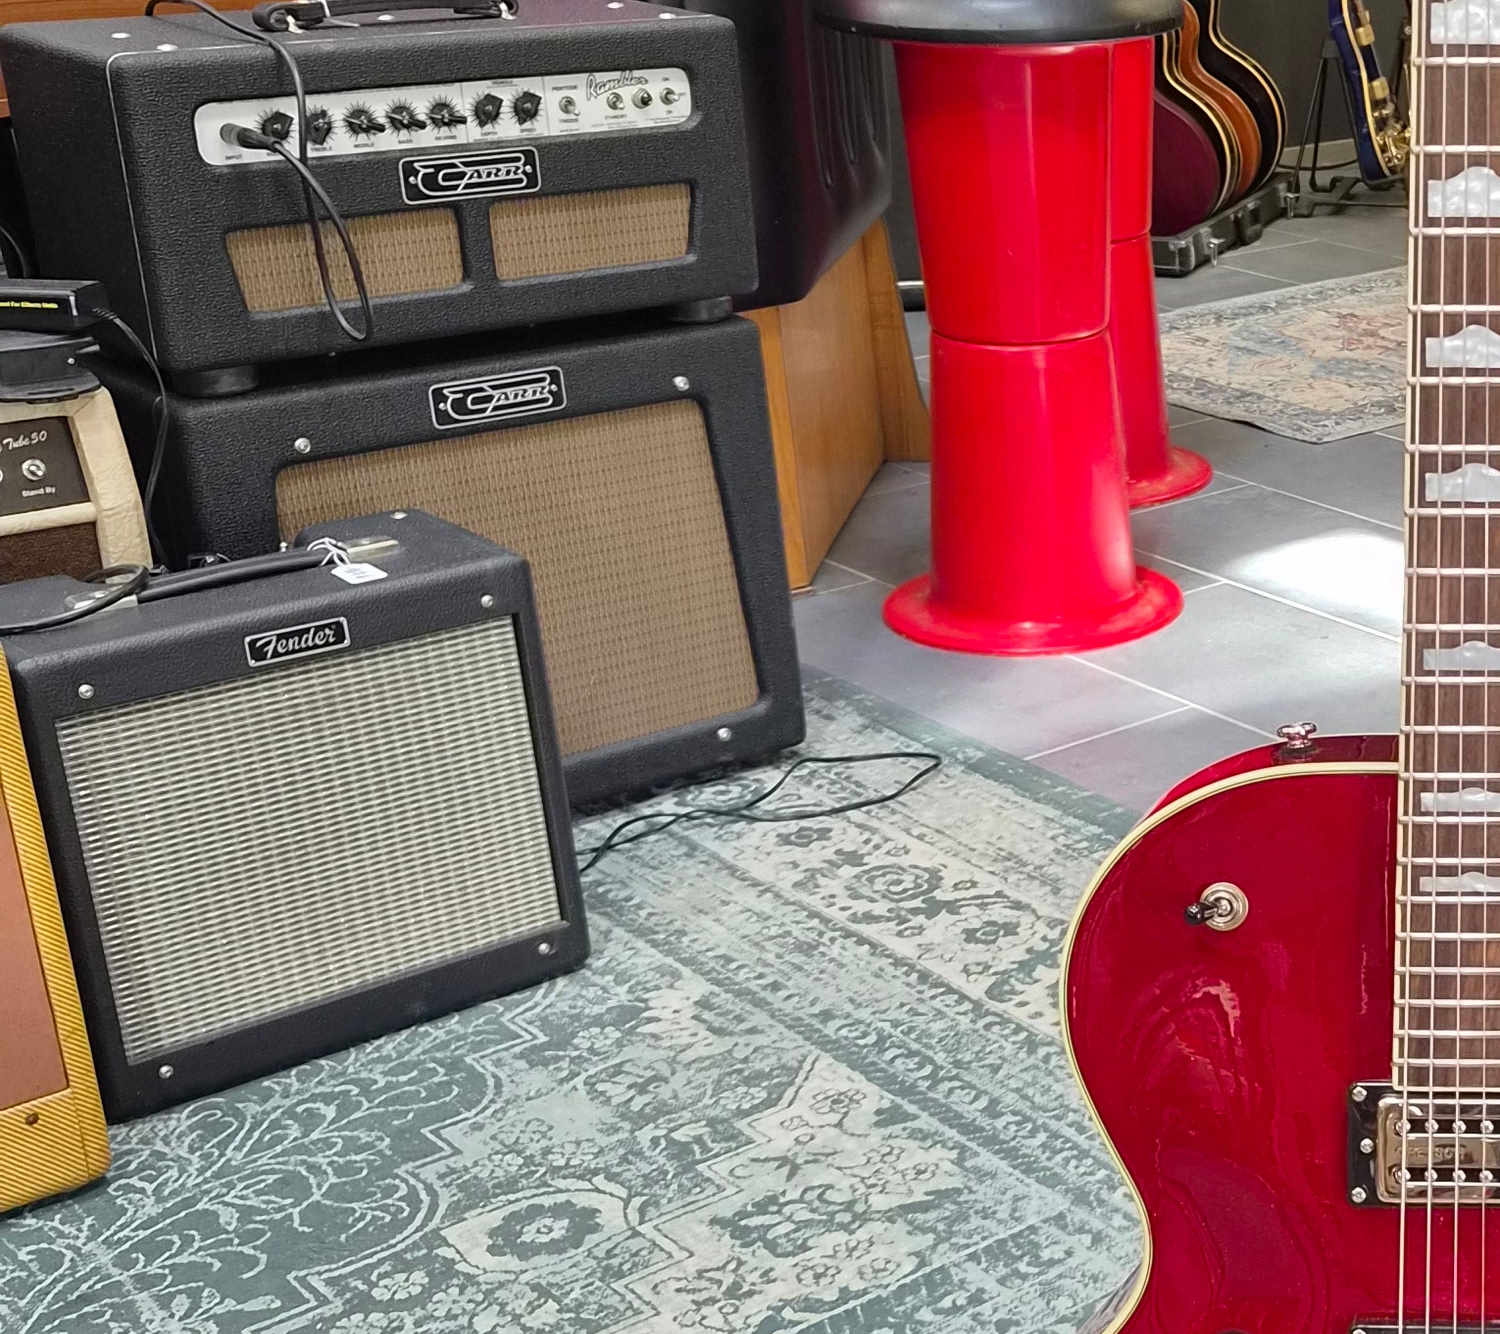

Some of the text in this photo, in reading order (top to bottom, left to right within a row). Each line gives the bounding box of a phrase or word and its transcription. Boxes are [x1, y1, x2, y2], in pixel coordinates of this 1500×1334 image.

[586, 70, 649, 101] Rambler
[413, 153, 528, 196] CARR
[443, 373, 554, 420] CARR
[255, 627, 336, 659] Fender
